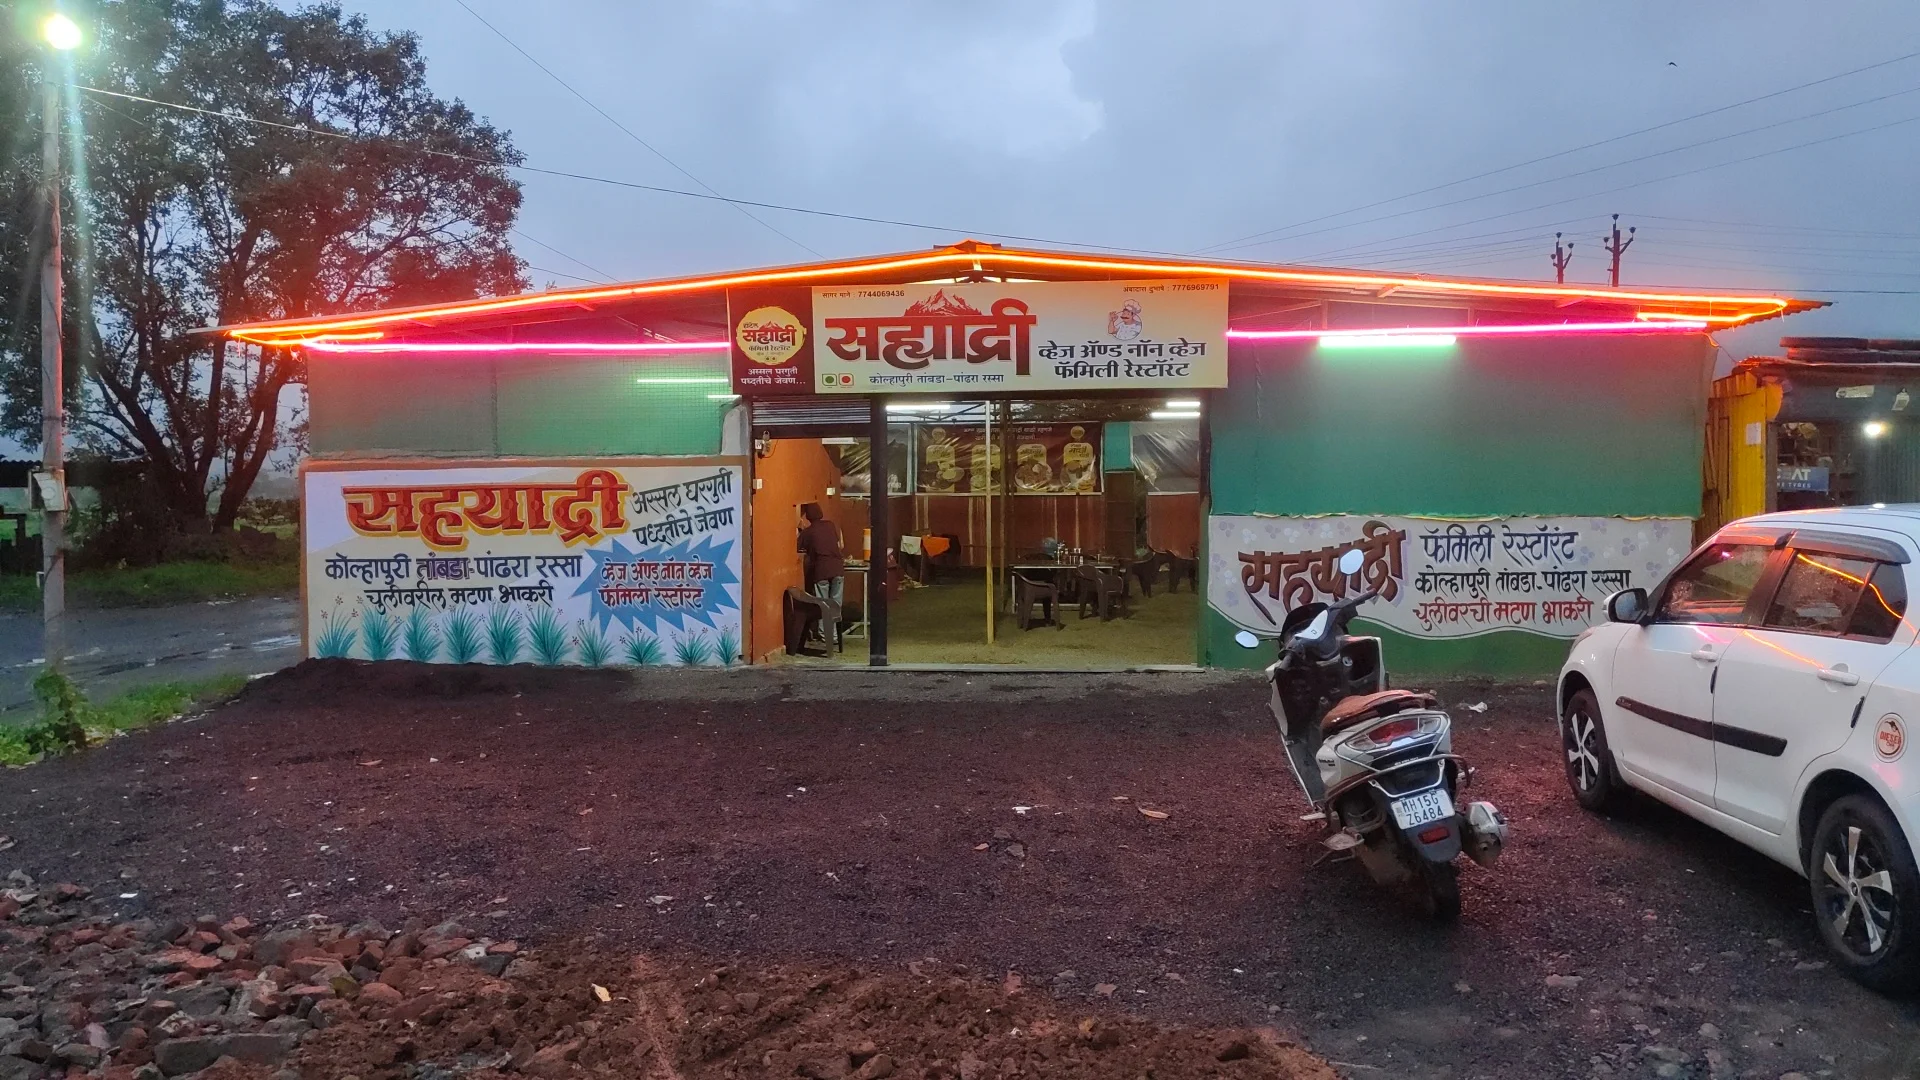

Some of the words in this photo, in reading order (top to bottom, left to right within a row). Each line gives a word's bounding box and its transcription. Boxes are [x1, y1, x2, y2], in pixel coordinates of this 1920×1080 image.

[858, 290, 905, 298] 7744069436
[1172, 283, 1219, 291] 7776969791
[742, 325, 797, 346] सह्याद्री
[825, 297, 1037, 376] सह्याद्री
[1038, 340, 1075, 359] व्हेज
[1127, 339, 1164, 357] नॉन
[1168, 337, 1207, 357] व्हेज
[748, 368, 773, 376] अस्सल
[775, 366, 798, 377] घरगुती
[869, 372, 914, 387] कोल्हापुरी
[982, 373, 1005, 383] रस्सा
[1054, 360, 1120, 379] फॅमिली
[1123, 357, 1190, 378] रेस्टॉरंट
[631, 483, 681, 514] अस्सल
[683, 467, 733, 504] घरगुती
[694, 505, 735, 533] जेवण
[1419, 523, 1496, 566] फॅमिली
[325, 553, 412, 585] कोल्हापुरी
[535, 555, 583, 578] रस्सा
[601, 557, 628, 582] व्हेज
[661, 556, 687, 580] नॉन
[688, 554, 714, 582] व्हेज
[1414, 564, 1492, 598] कोल्हापुरी
[1591, 569, 1632, 596] रस्सा
[363, 580, 447, 615] चुलीवरील
[448, 587, 494, 606] मटण
[498, 579, 555, 608] भाकरी
[598, 582, 652, 607] फॅमिली
[1412, 597, 1493, 632] चुलीवरची
[1493, 601, 1538, 625] मटण
[1541, 594, 1595, 628] भाकरी
[1400, 791, 1439, 813] MH15G
[1405, 805, 1444, 826] Z6484
